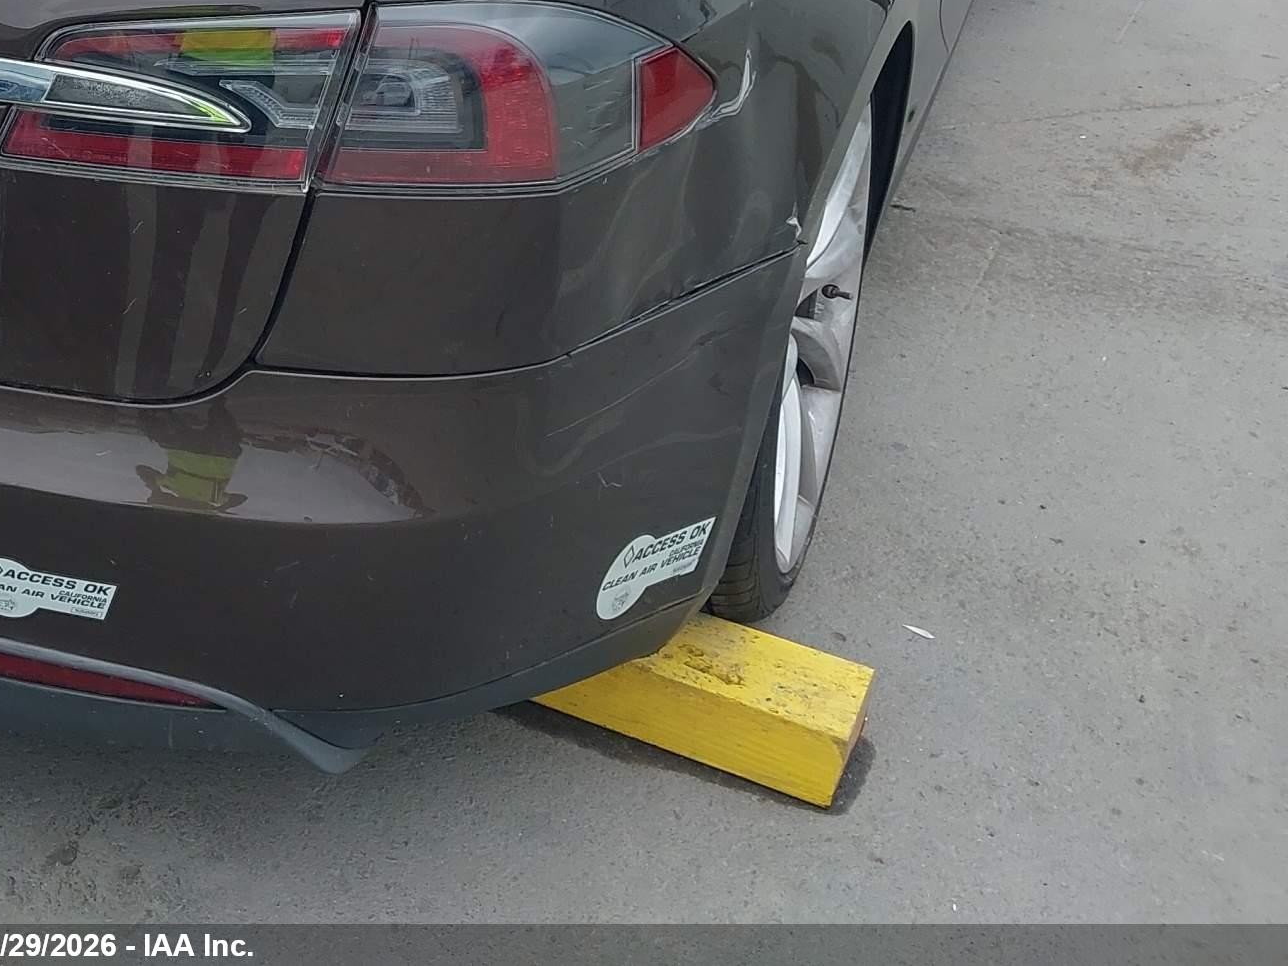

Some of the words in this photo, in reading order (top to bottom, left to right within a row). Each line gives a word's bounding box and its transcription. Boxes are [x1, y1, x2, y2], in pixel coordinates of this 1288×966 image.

[632, 531, 687, 563] ACCESS
[690, 521, 711, 540] OK
[602, 570, 638, 591] CLEAN
[639, 563, 658, 577] AIR
[660, 546, 702, 569] VEHICLE
[3, 569, 78, 590] ACCESS
[83, 583, 112, 596] OK
[21, 588, 45, 598] AIR
[50, 593, 108, 610] VEHICLE
[58, 590, 108, 604] CALIFORNIA
